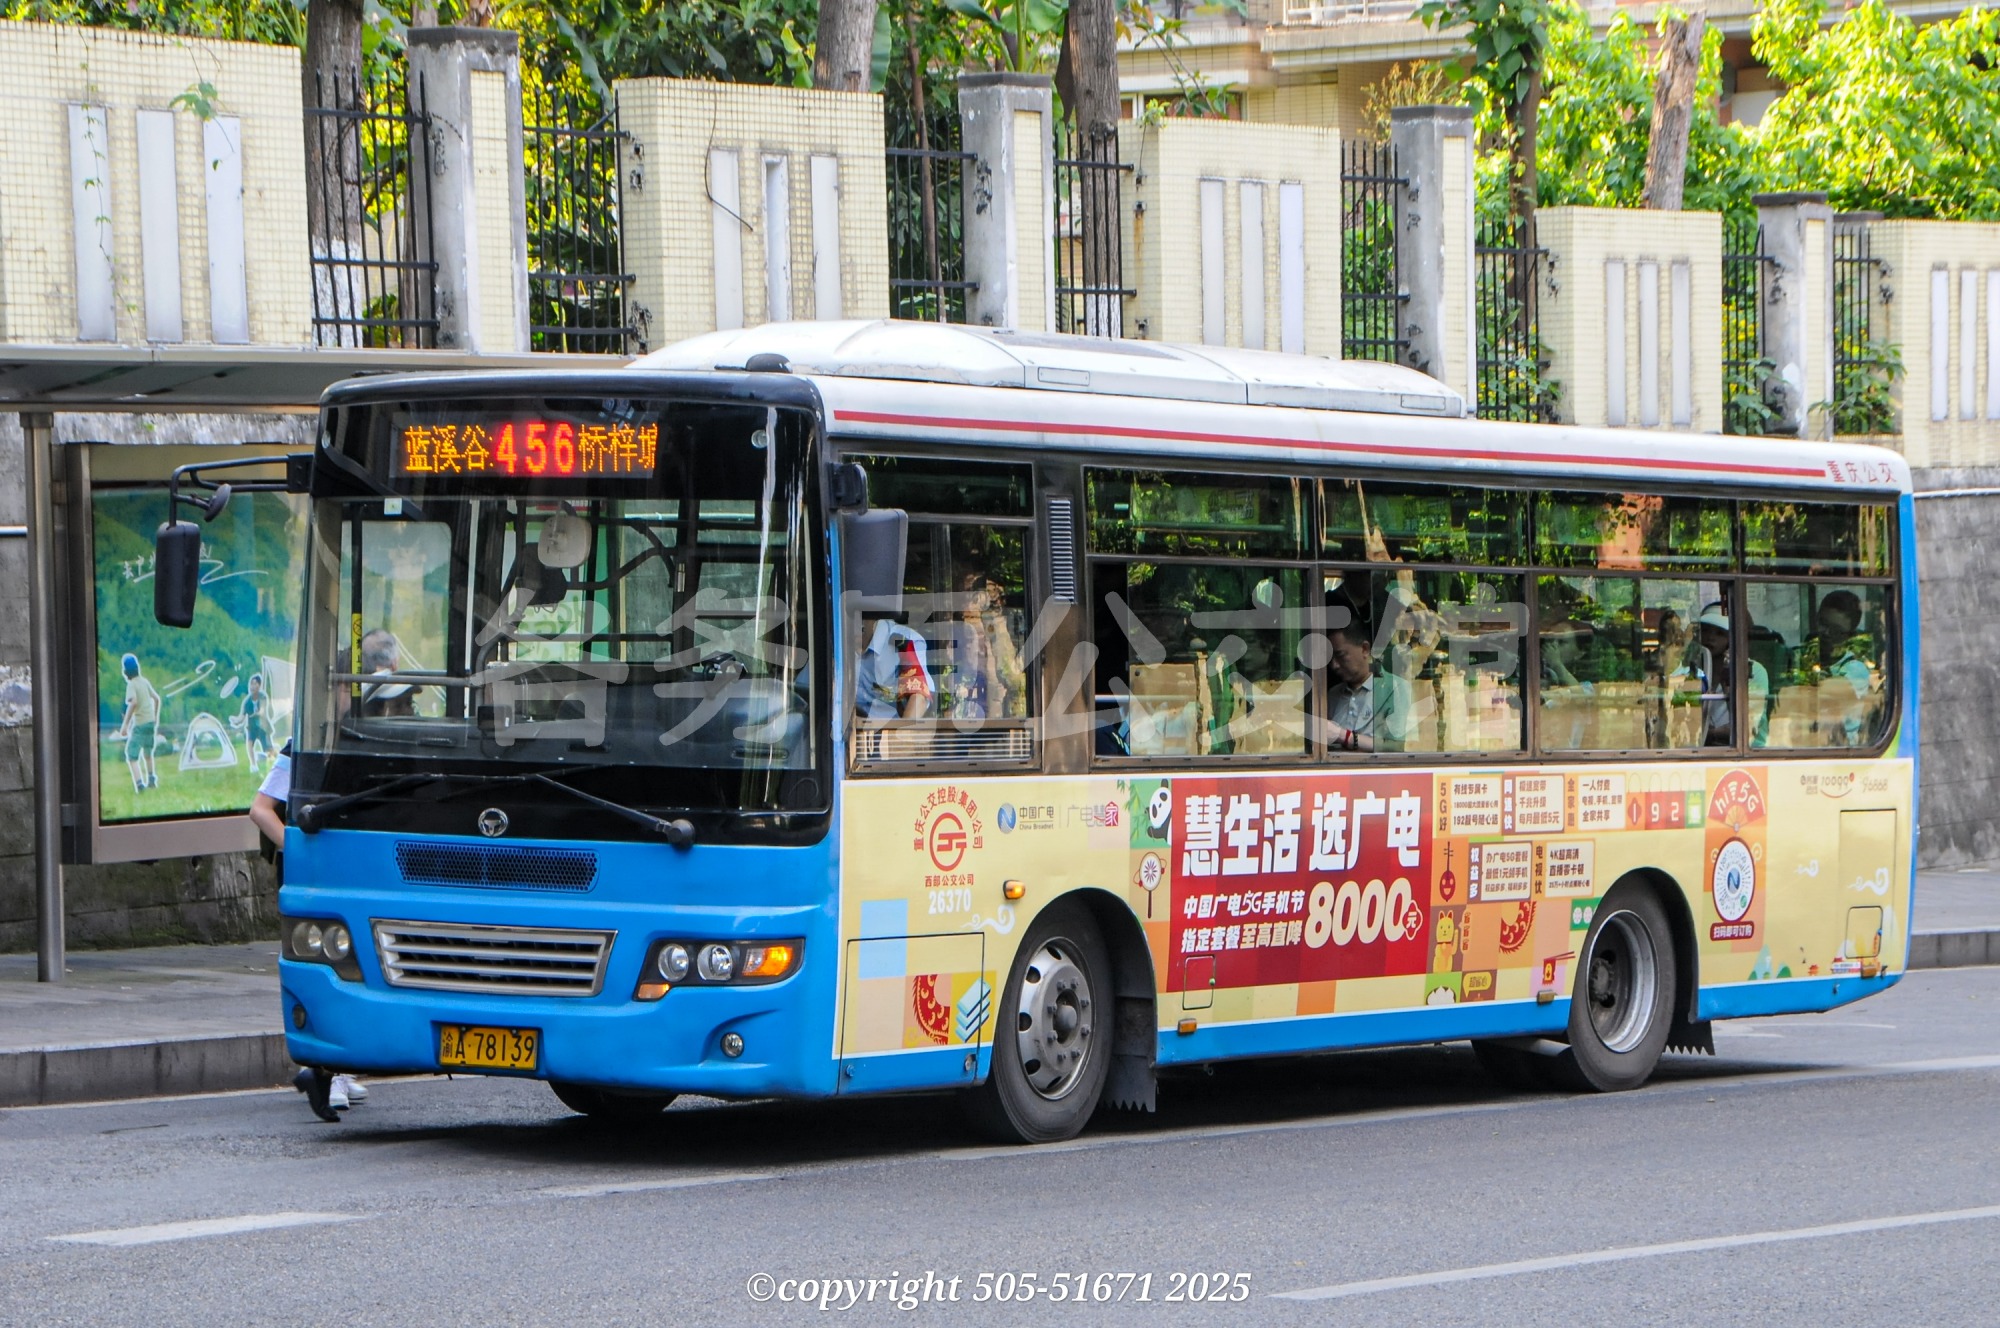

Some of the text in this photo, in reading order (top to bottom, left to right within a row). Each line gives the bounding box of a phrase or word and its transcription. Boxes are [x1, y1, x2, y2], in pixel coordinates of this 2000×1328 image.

[494, 421, 576, 475] 456
[1582, 779, 1611, 791] 一人付费
[1019, 805, 1055, 820] 中国广电
[1582, 809, 1611, 823] 全家共享
[1182, 789, 1422, 877] 慧生活 选广电
[924, 873, 975, 888] 西部公交公司
[928, 889, 972, 916] 26370
[1183, 889, 1306, 920] 中国广电5G手机节
[1181, 919, 1303, 953] 指定套餐至高直降
